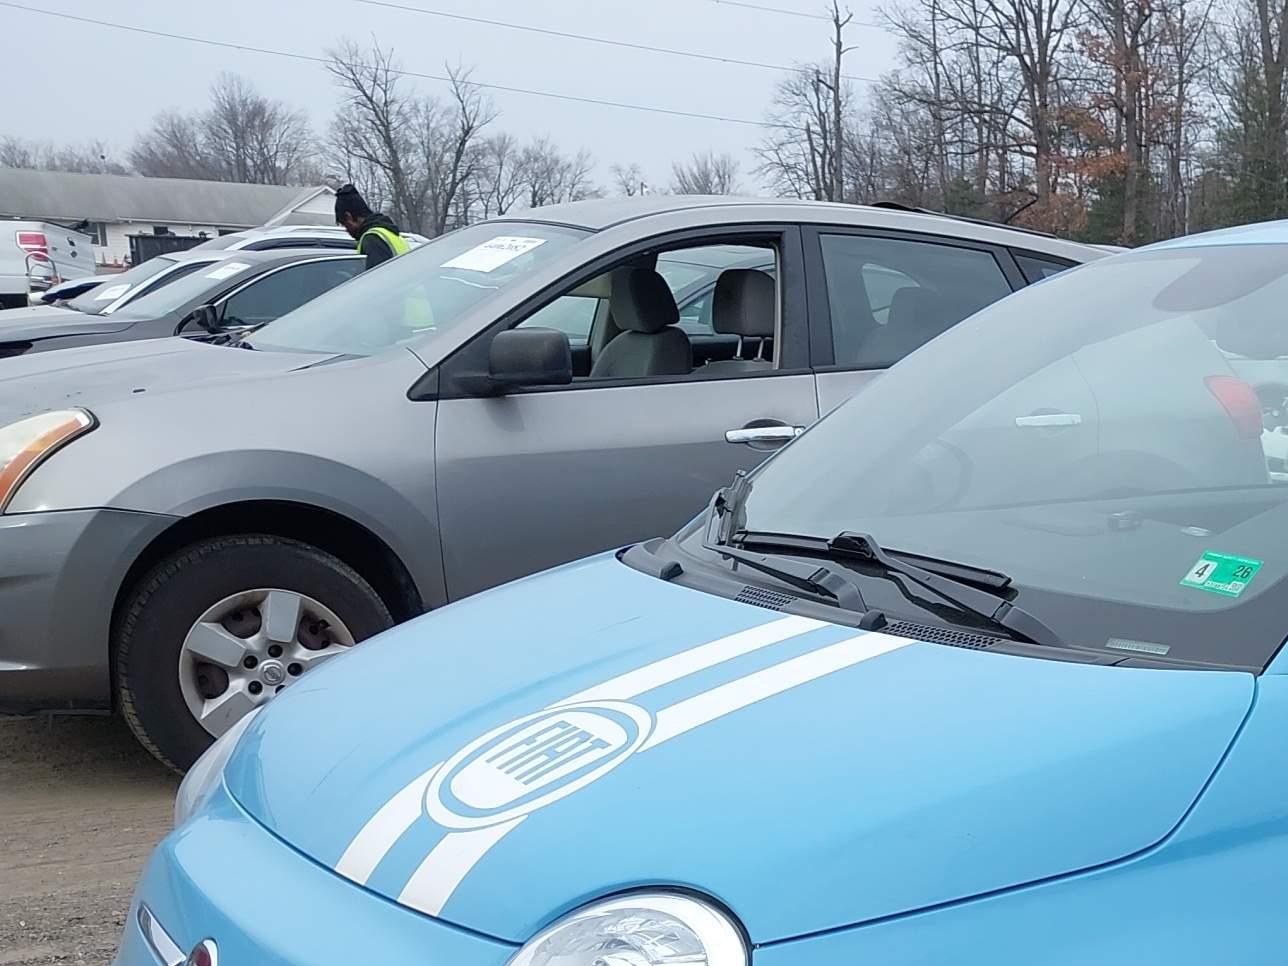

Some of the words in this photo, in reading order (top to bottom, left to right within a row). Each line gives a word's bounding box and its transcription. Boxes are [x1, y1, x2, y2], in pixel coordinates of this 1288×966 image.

[1195, 563, 1210, 578] 4
[1232, 565, 1253, 579] 26
[484, 719, 612, 786] FIAT
